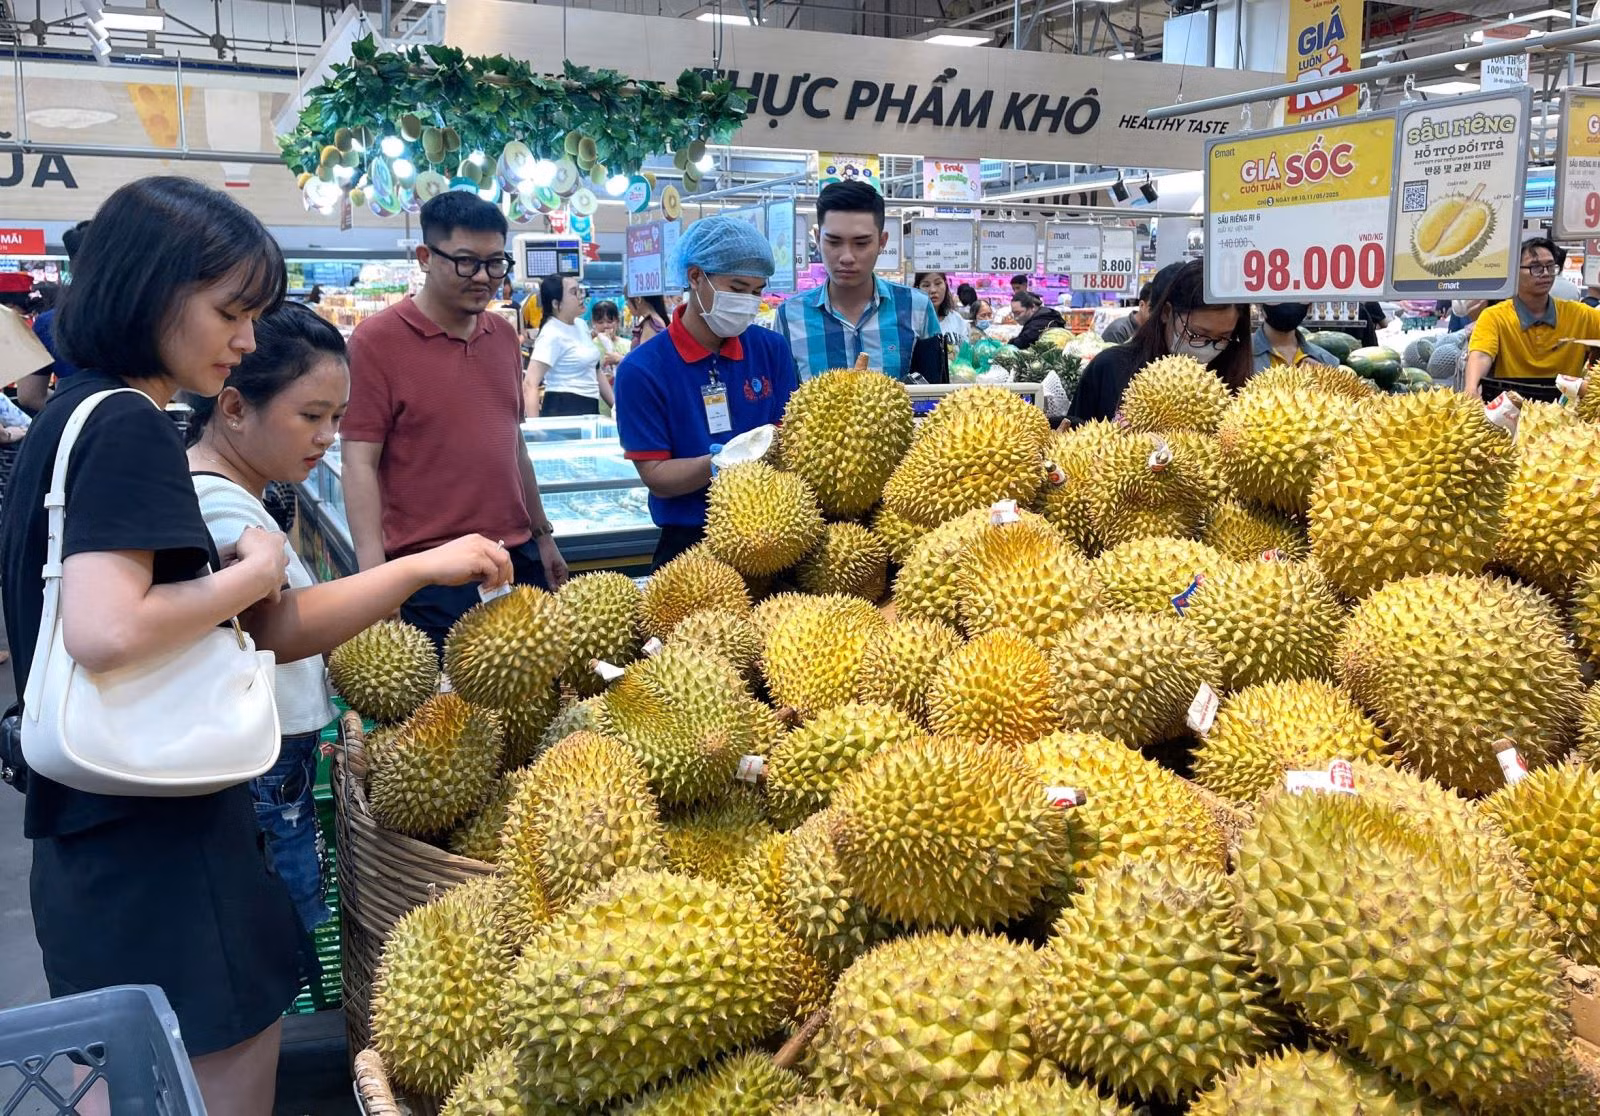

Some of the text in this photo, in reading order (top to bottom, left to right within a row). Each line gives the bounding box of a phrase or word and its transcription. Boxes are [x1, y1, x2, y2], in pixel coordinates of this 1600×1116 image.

[1298, 5, 1345, 56] GIÁ
[1298, 53, 1322, 71] LUÔN
[844, 68, 994, 129] PHẨM
[999, 87, 1101, 136] KHÔ
[1119, 114, 1230, 135] HEALTHY TASTE
[1215, 148, 1235, 159] emart
[1285, 135, 1355, 187] SỐC
[1240, 152, 1281, 183] GIÁ
[915, 228, 939, 236] emart
[982, 229, 1005, 239] emart
[1048, 231, 1070, 240] emart
[991, 256, 1033, 270] 36.800
[1243, 242, 1385, 292] 98.000
[1083, 274, 1125, 289] 18.800
[1438, 281, 1460, 289] emart
